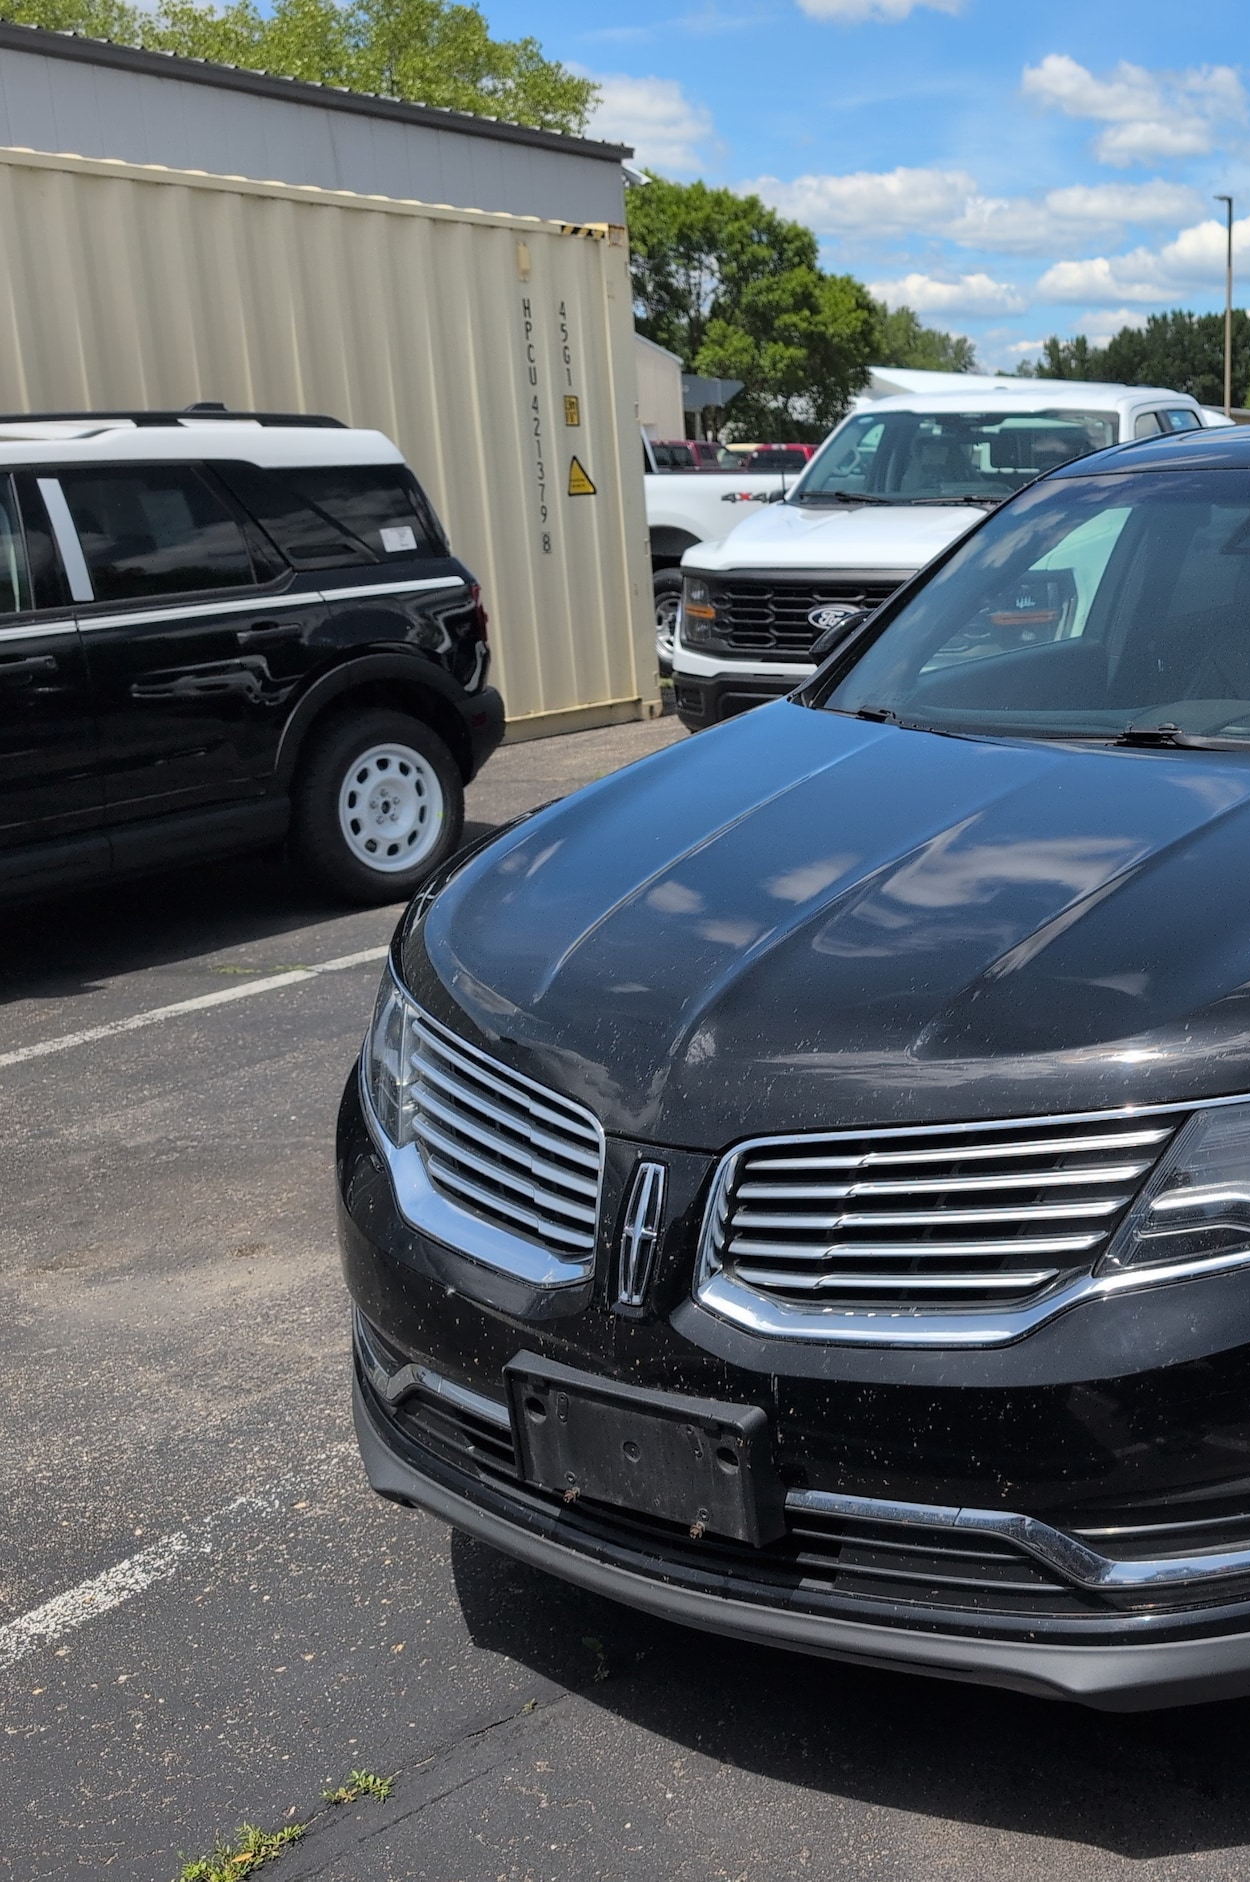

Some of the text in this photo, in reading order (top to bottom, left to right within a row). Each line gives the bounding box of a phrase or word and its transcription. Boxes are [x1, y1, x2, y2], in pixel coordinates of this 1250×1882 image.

[523, 299, 537, 385] HPCU
[531, 396, 547, 523] 421379
[559, 302, 572, 386] 45G1
